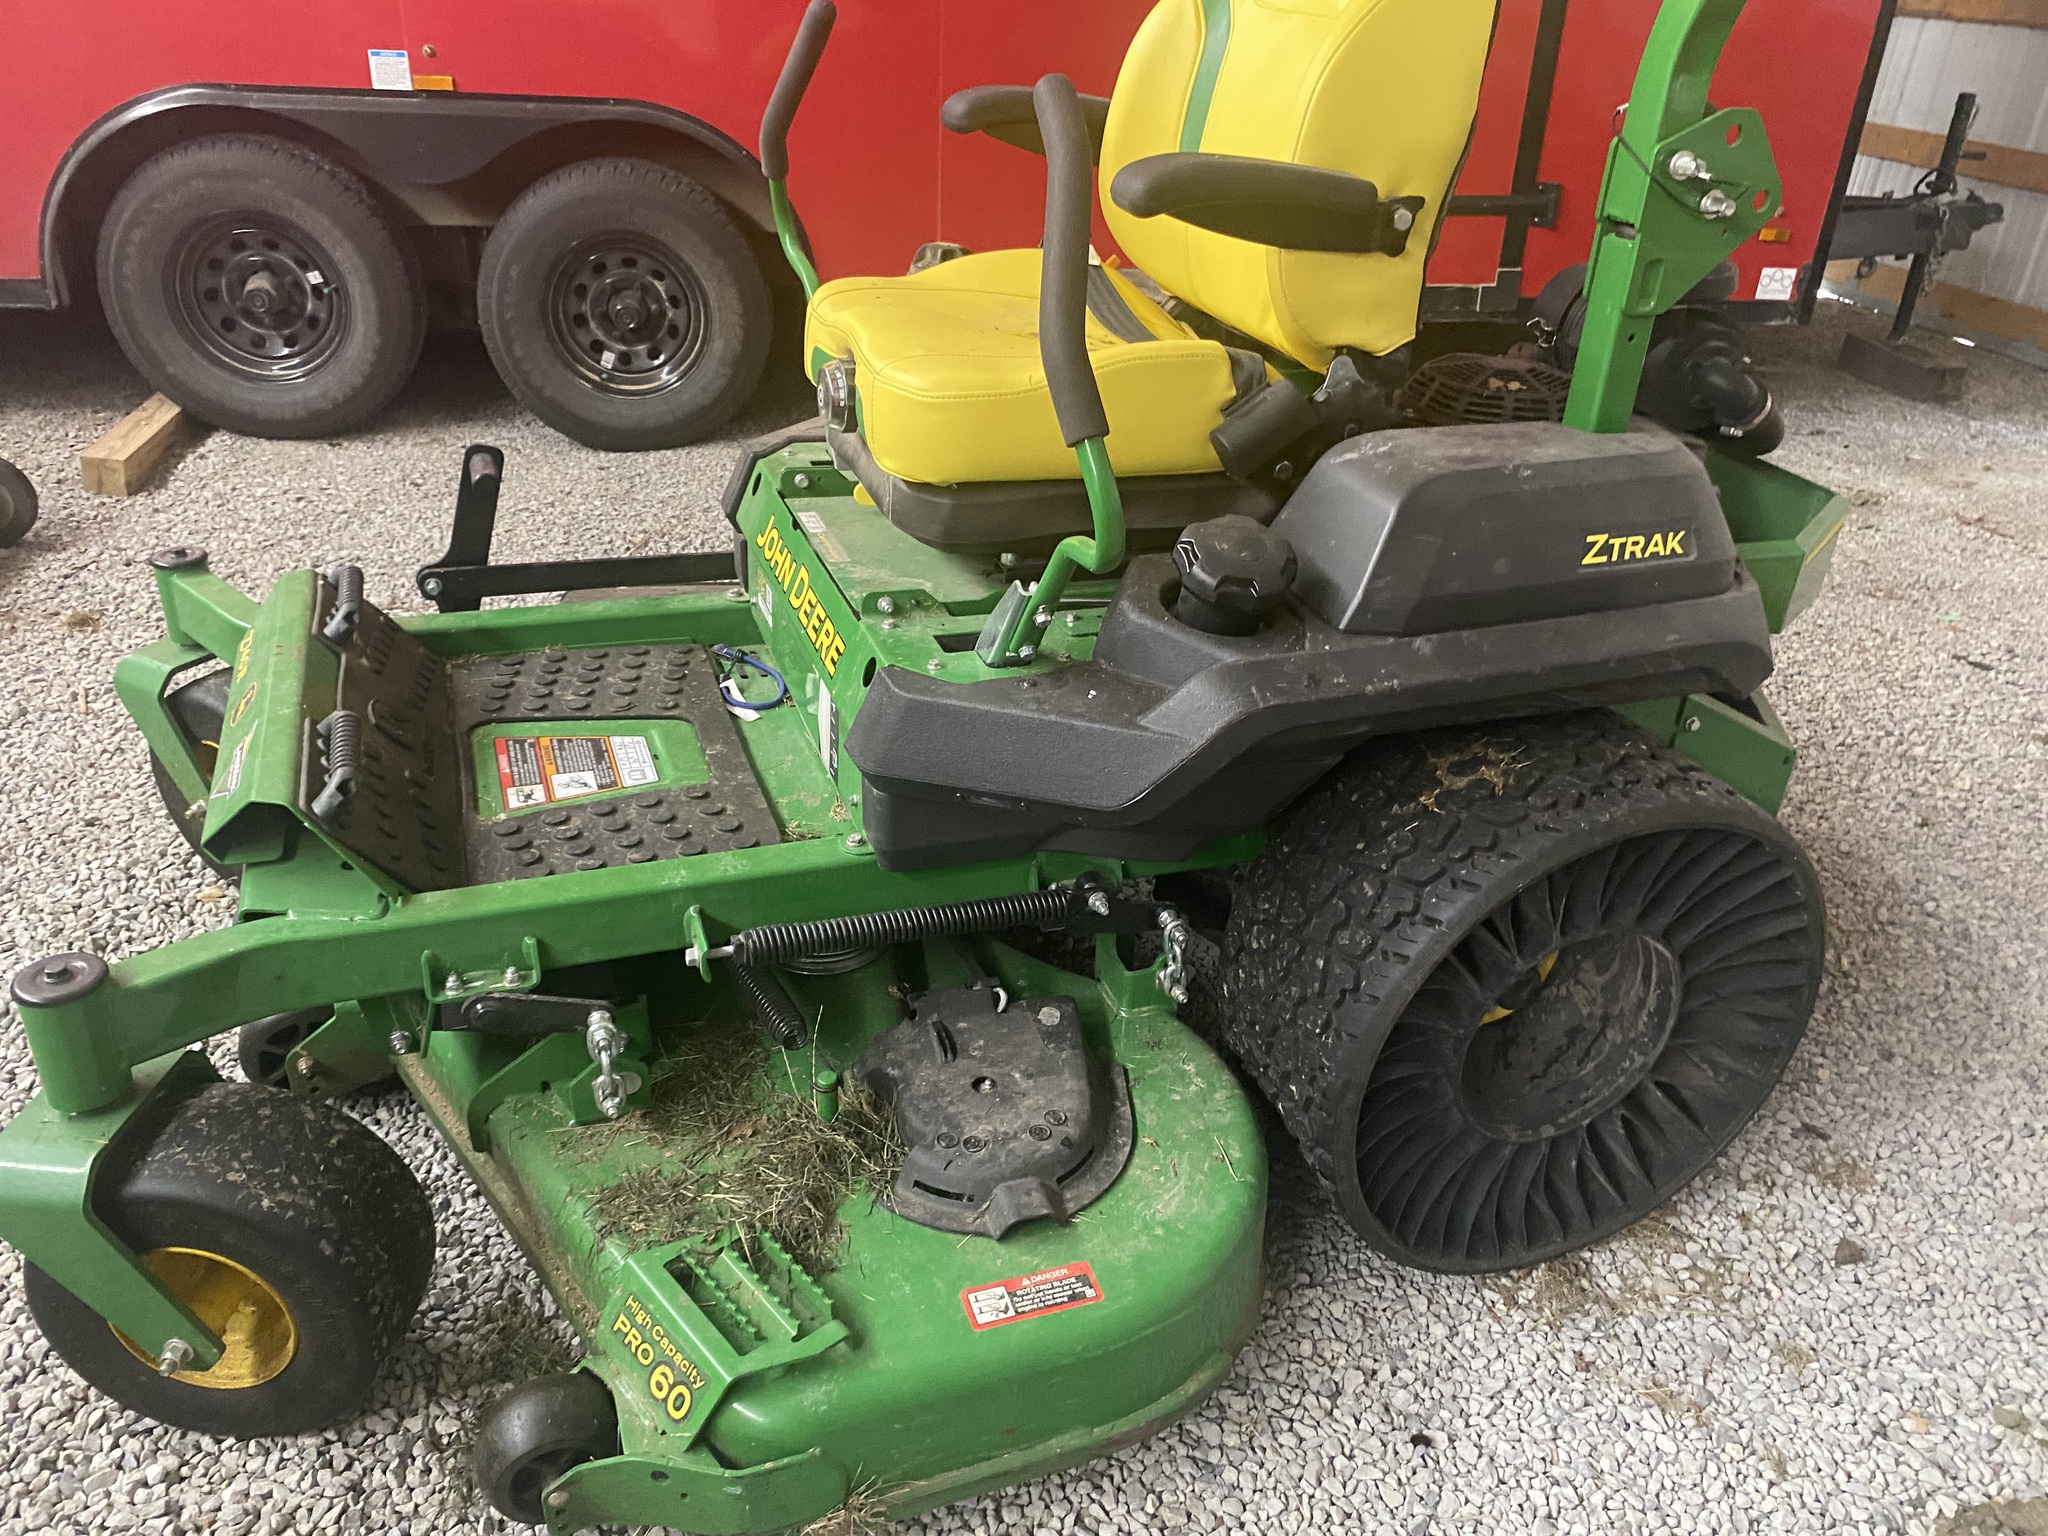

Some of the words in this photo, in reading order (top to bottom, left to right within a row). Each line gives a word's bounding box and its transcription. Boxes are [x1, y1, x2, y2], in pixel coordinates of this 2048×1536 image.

[1581, 530, 1686, 565] ZTRAK
[756, 514, 797, 594] JOHN
[788, 563, 847, 680] DEERE
[1016, 1283, 1052, 1296] ROTATING
[1052, 1276, 1076, 1287] BLADE
[1031, 1268, 1068, 1283] DANGER
[1044, 1287, 1063, 1296] hands
[625, 1294, 653, 1331] High
[652, 1325, 705, 1390] Capacity
[613, 1313, 654, 1366] PRO
[650, 1364, 692, 1420] 60
